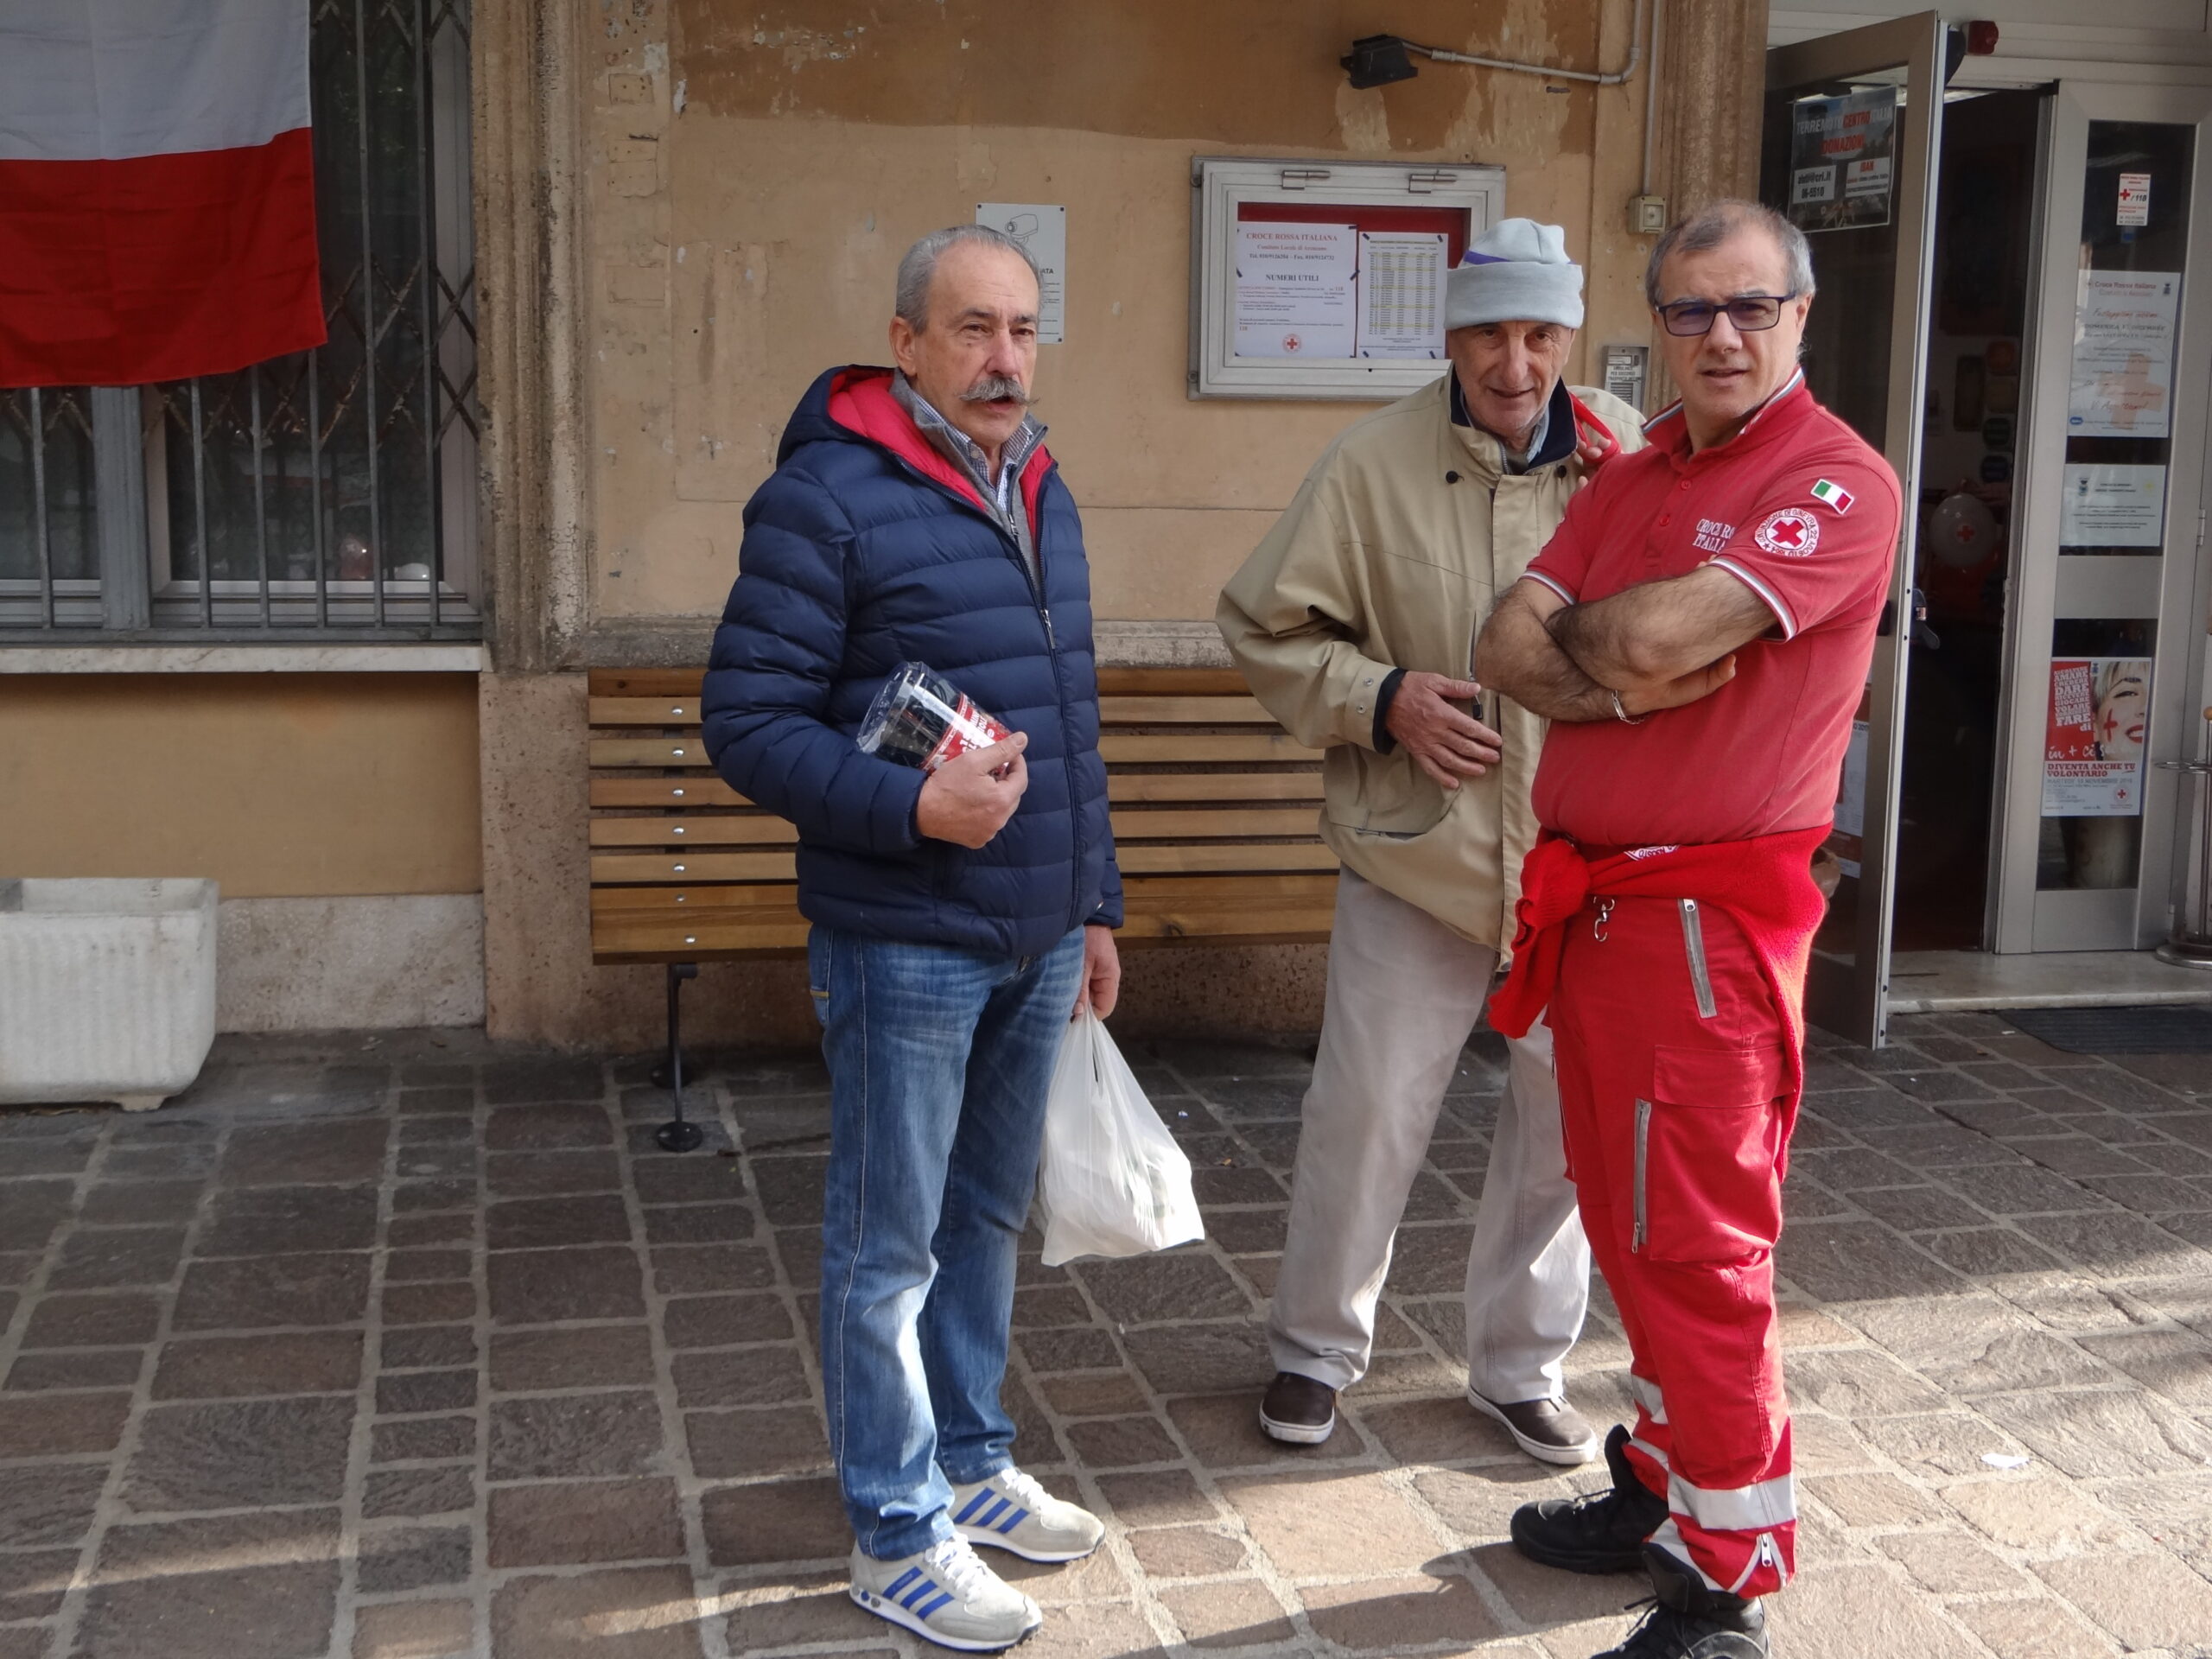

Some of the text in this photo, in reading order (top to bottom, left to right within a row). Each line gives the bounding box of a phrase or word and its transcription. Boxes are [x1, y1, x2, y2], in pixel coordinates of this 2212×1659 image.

[1843, 111, 1871, 128] CENTRO
[1859, 161, 1874, 172] IBAN
[1695, 518, 1723, 537] CROCE
[1792, 509, 1816, 530] GINEVRA
[1809, 530, 1818, 540] 22
[2054, 671, 2088, 683] AMARE
[2055, 683, 2089, 696] DARE
[2055, 697, 2089, 707] GIOCARE
[2056, 713, 2091, 727] FARE
[2080, 722, 2091, 732] di
